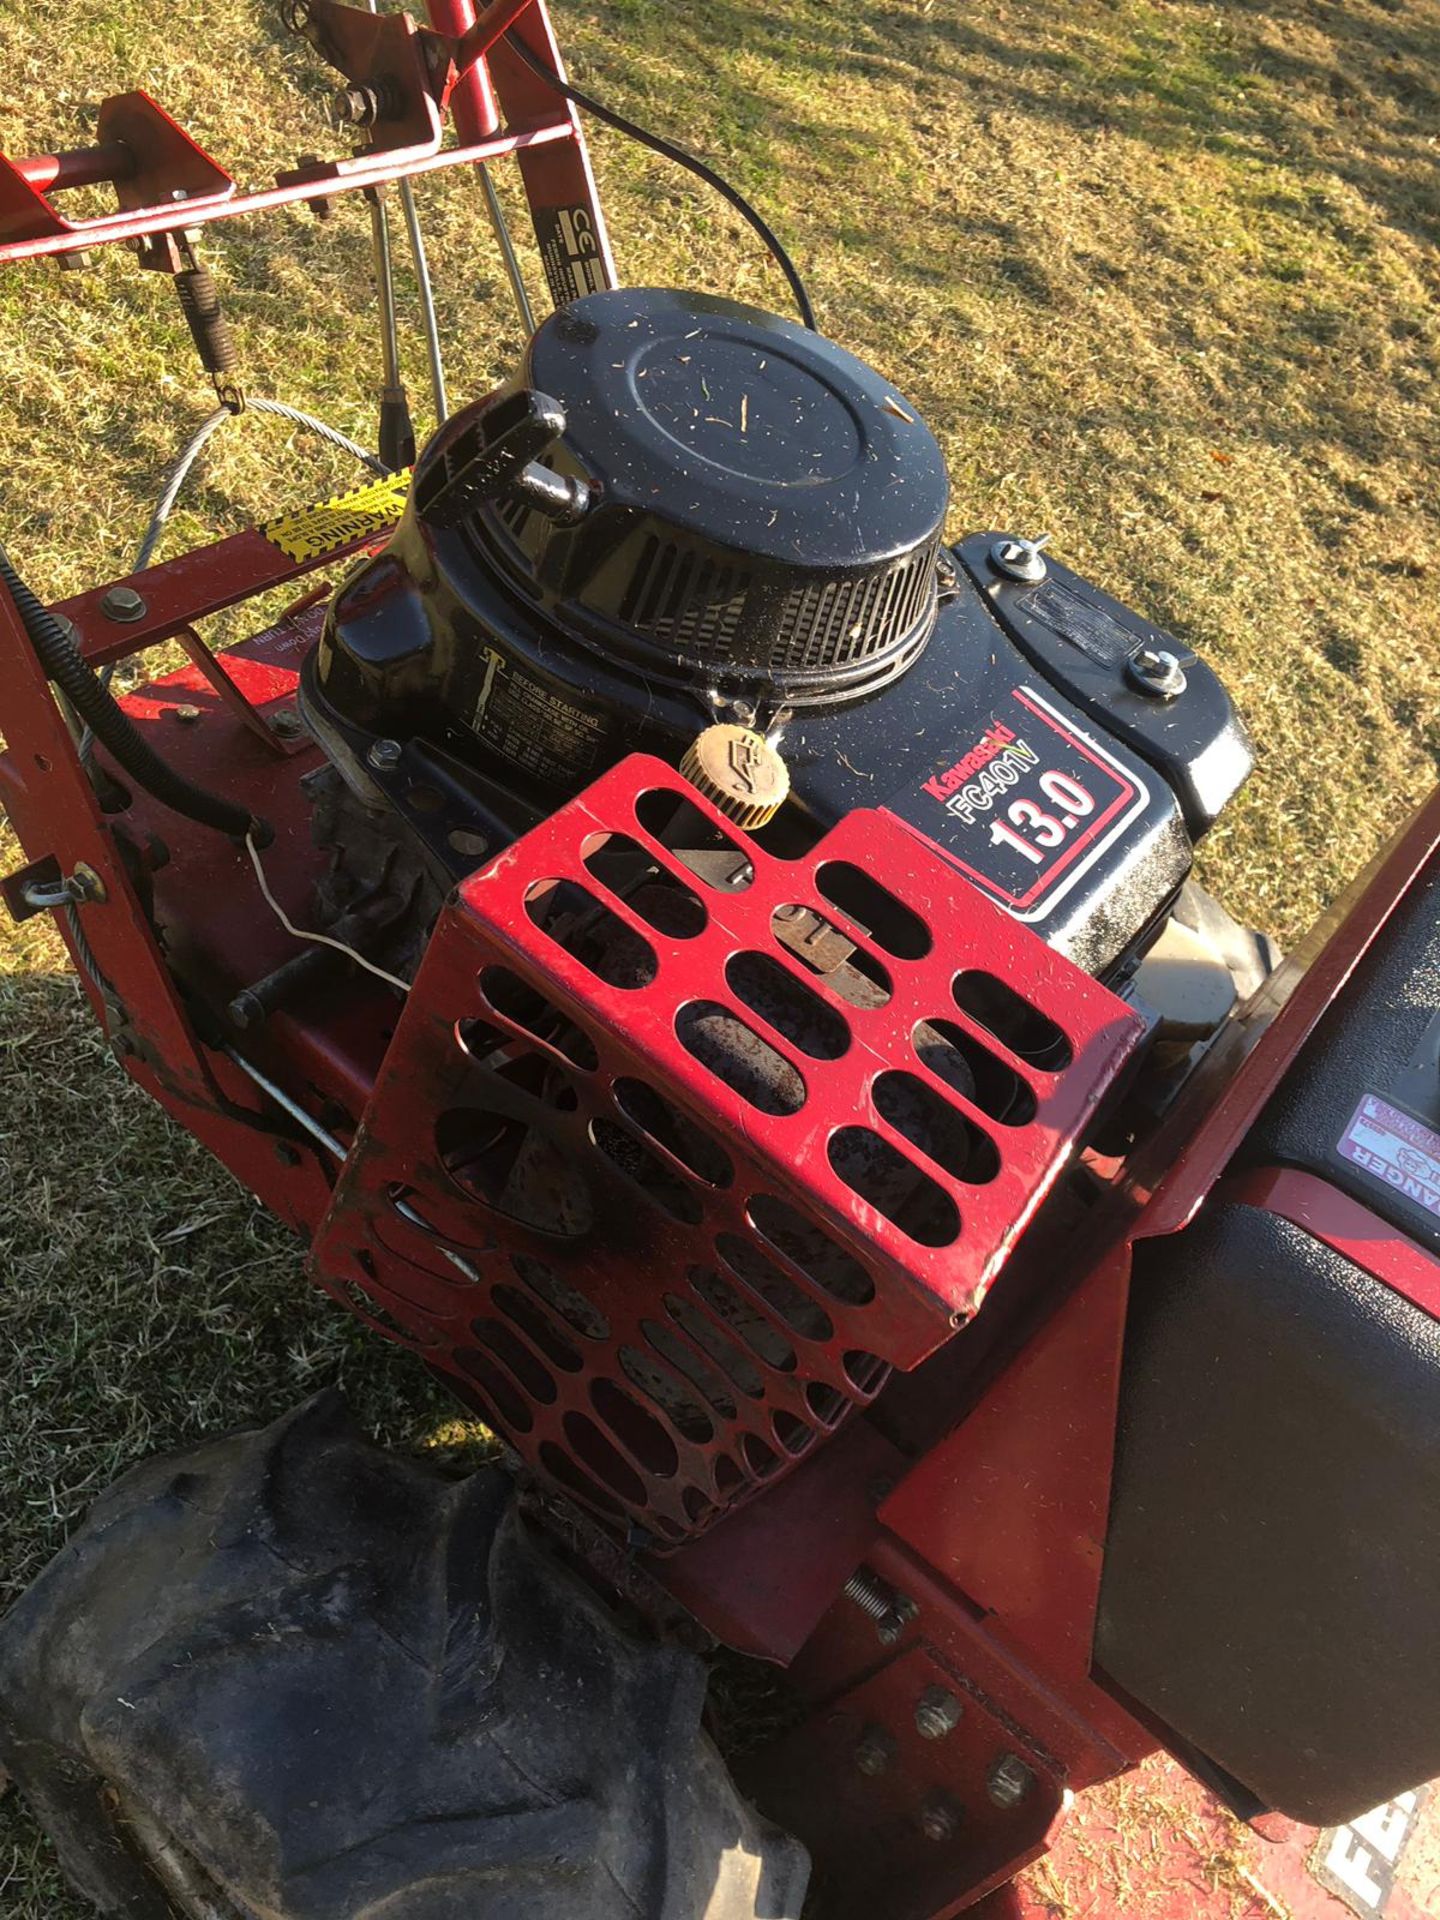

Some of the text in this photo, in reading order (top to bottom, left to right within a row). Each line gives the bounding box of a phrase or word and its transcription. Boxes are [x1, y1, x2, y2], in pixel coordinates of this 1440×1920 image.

[573, 208, 596, 254] CE
[304, 503, 404, 547] WARNING
[549, 695, 599, 728] STARTING
[921, 720, 1016, 802] Kawasaki
[945, 738, 1040, 825] FC401V
[989, 769, 1096, 865] 13.0
[1351, 1145, 1440, 1213] ANGER
